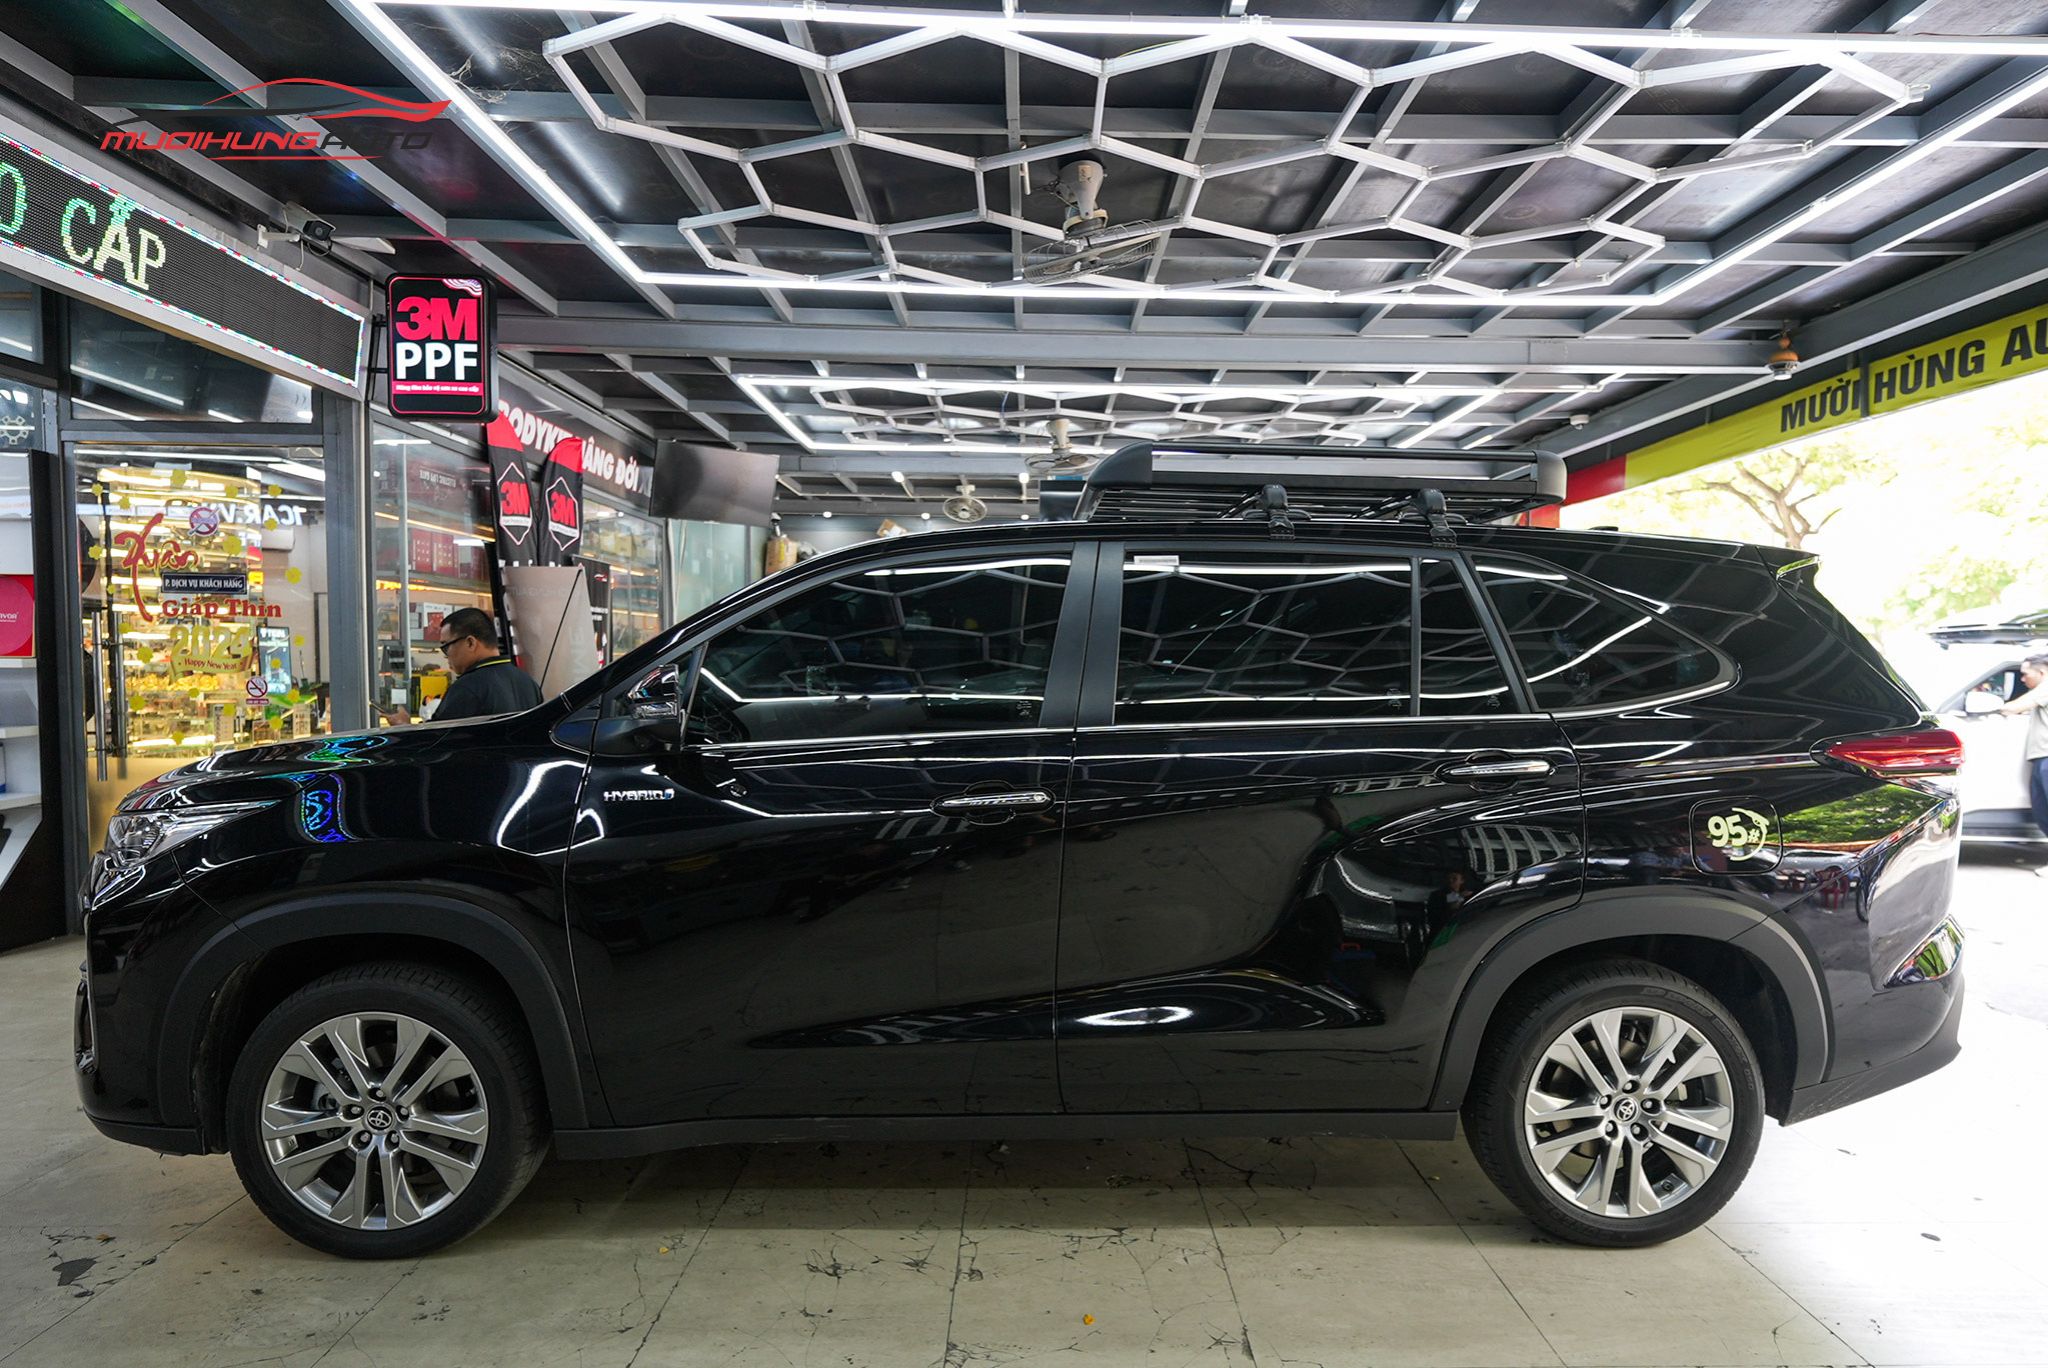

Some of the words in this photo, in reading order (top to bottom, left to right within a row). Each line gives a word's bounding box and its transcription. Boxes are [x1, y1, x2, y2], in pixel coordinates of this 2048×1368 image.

[396, 297, 478, 341] 3M
[396, 342, 478, 380] PPF
[1780, 378, 1863, 433] MƯỜI
[1874, 340, 1986, 404] HÙNG
[582, 436, 614, 480] ÂNG
[501, 480, 530, 515] 3M
[550, 491, 577, 527] 3M
[171, 578, 188, 589] DỊCH
[199, 577, 222, 588] KHÁCH
[223, 578, 243, 588] HÀNG
[162, 597, 219, 618] Giáp
[170, 625, 253, 659] 2024
[184, 658, 205, 668] Happy
[207, 660, 222, 669] New
[222, 662, 238, 670] Year
[603, 790, 664, 801] HYBRID
